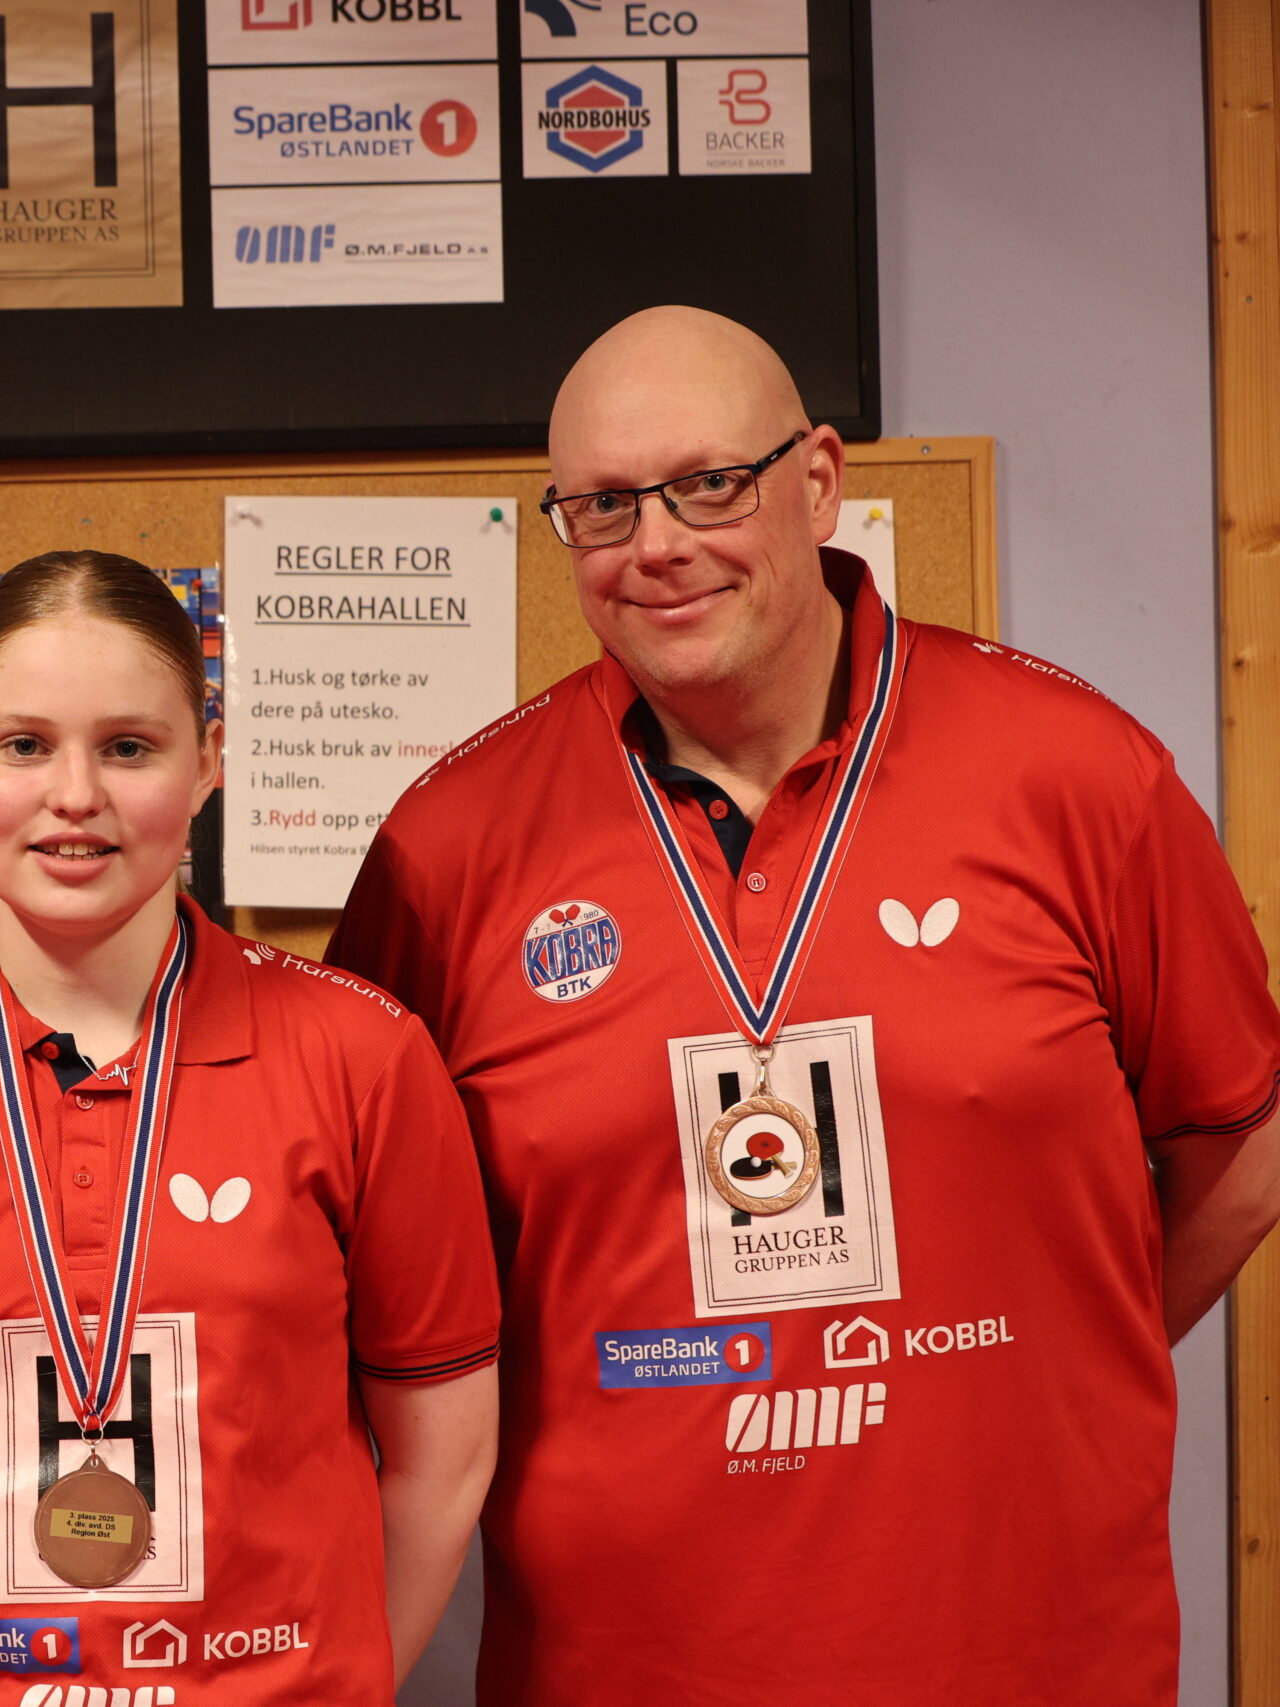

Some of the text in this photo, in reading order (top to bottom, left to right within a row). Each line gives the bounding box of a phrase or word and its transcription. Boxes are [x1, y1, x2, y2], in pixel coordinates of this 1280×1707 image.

[331, 0, 462, 22] KOBBL
[625, 4, 698, 36] Eco
[233, 103, 412, 139] SpareBank
[538, 109, 651, 130] NORDBOHUS
[280, 139, 414, 158] ØSTLANDET
[705, 131, 784, 150] BACKER
[94, 225, 119, 241] AS
[276, 545, 451, 571] REGLER FOR
[256, 595, 466, 621] KOBRAHALLEN
[322, 672, 345, 690] og
[351, 669, 401, 687] tørke
[407, 672, 429, 687] av
[251, 701, 400, 722] dere på utesko.
[321, 740, 365, 758] bruk
[370, 744, 392, 758] av
[251, 771, 325, 790] i hallen.
[322, 814, 359, 832] opp
[250, 843, 285, 855] Hilsen
[288, 844, 321, 857] styret
[324, 844, 357, 856] Kobra
[526, 917, 618, 986] KOBRA
[282, 954, 401, 1018] Hafslund
[557, 975, 592, 998] BTK
[733, 1226, 847, 1255] HAUGER
[734, 1248, 849, 1274] GRUPPEN AS
[905, 1316, 1014, 1356] KOBBL
[604, 1336, 719, 1365] SpareBank
[634, 1361, 720, 1378] ØSTLANDET
[727, 1455, 805, 1475] Ø.M. FJELD
[99, 1514, 114, 1522] 2025
[71, 1528, 95, 1537] Region
[204, 1622, 310, 1661] KOBBL
